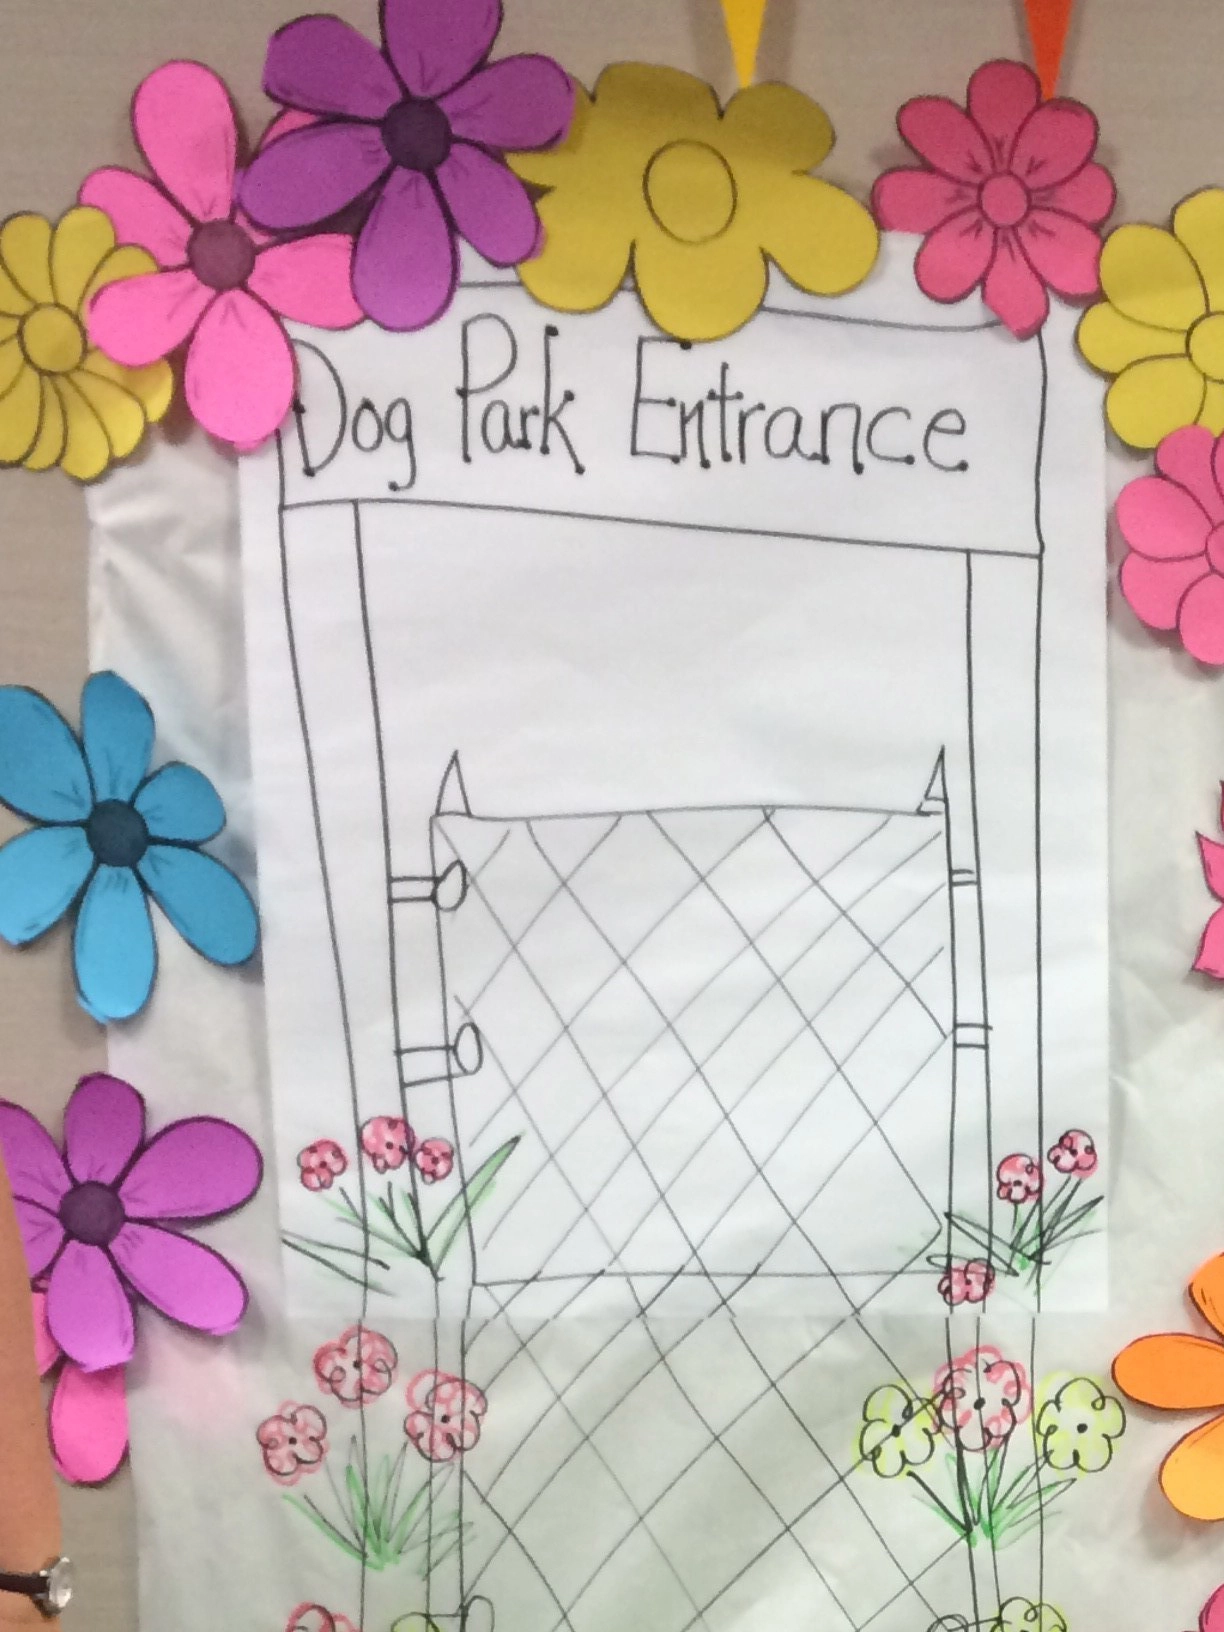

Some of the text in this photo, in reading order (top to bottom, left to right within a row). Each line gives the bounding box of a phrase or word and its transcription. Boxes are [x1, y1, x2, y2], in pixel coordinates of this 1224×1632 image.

[293, 313, 970, 490] Dog Park Entrance
